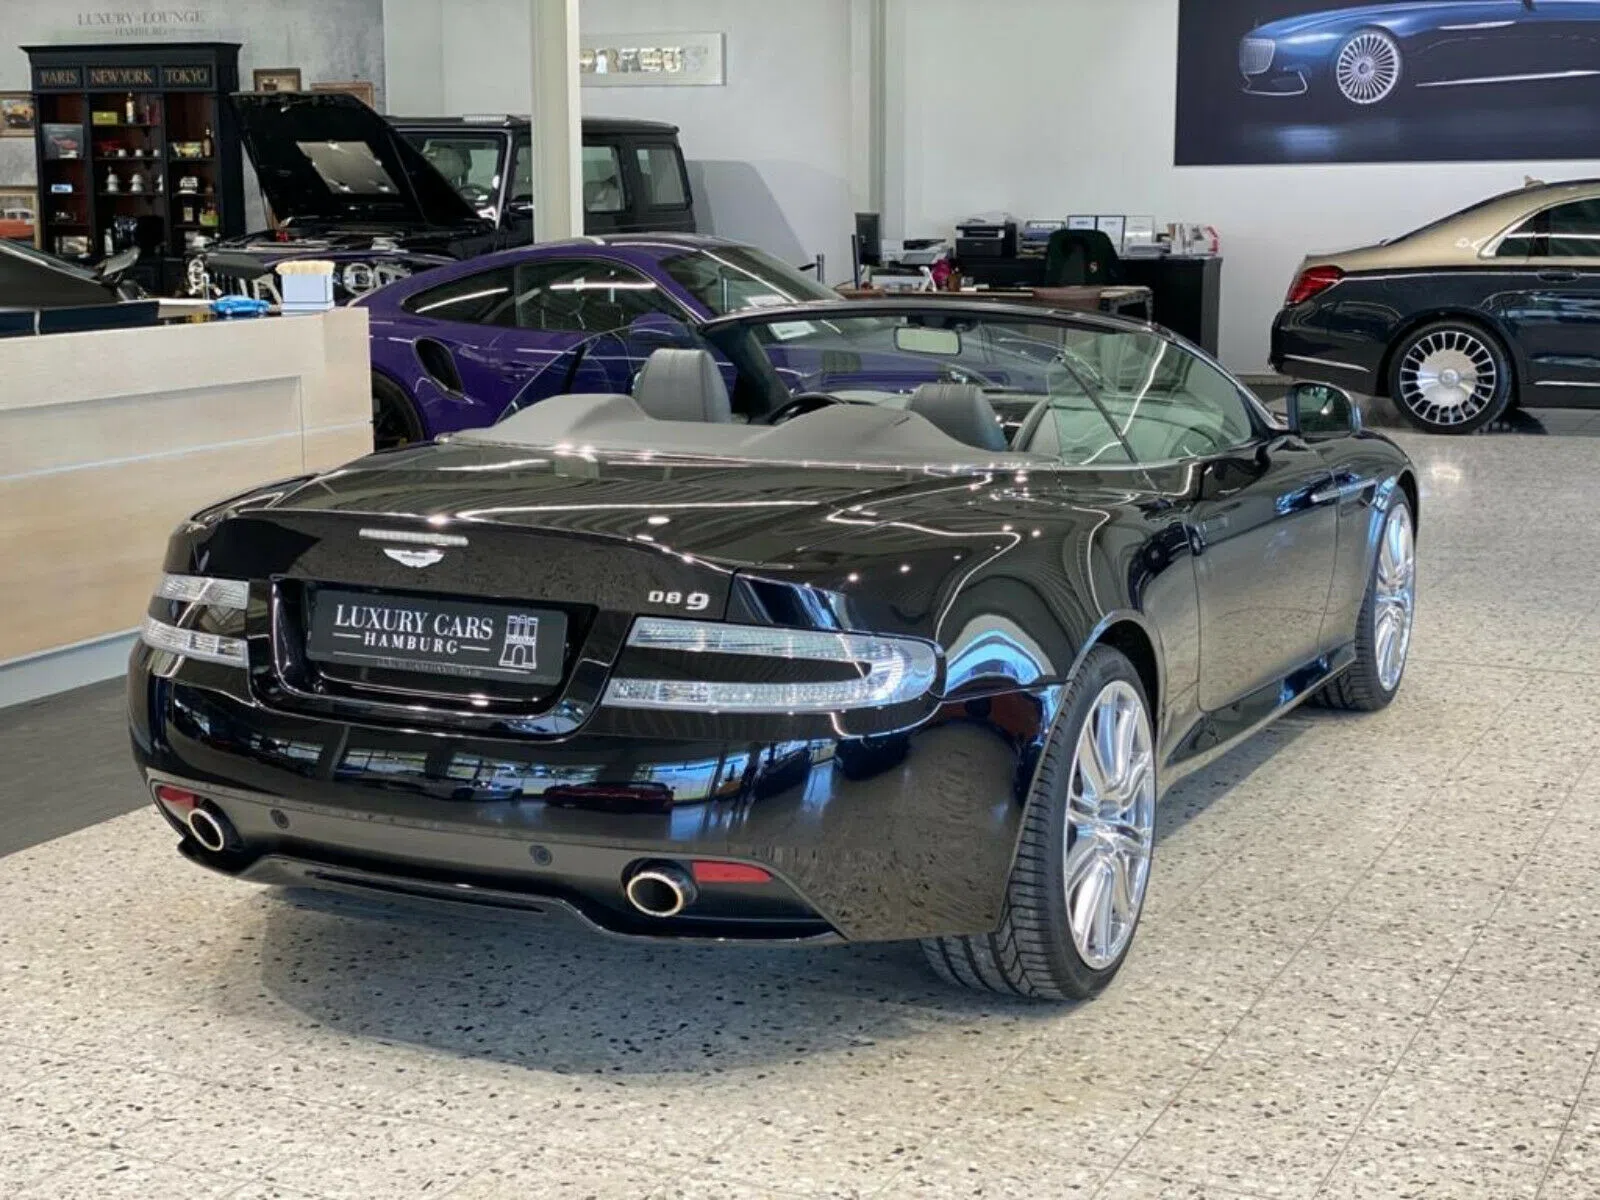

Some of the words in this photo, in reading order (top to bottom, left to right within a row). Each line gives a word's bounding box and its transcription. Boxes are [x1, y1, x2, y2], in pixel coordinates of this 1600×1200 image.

[40, 69, 78, 85] PARIS
[165, 68, 208, 84] TOKYO
[334, 603, 431, 635] LUXURY
[433, 612, 494, 641] CARS
[364, 631, 459, 655] HAMBURG
